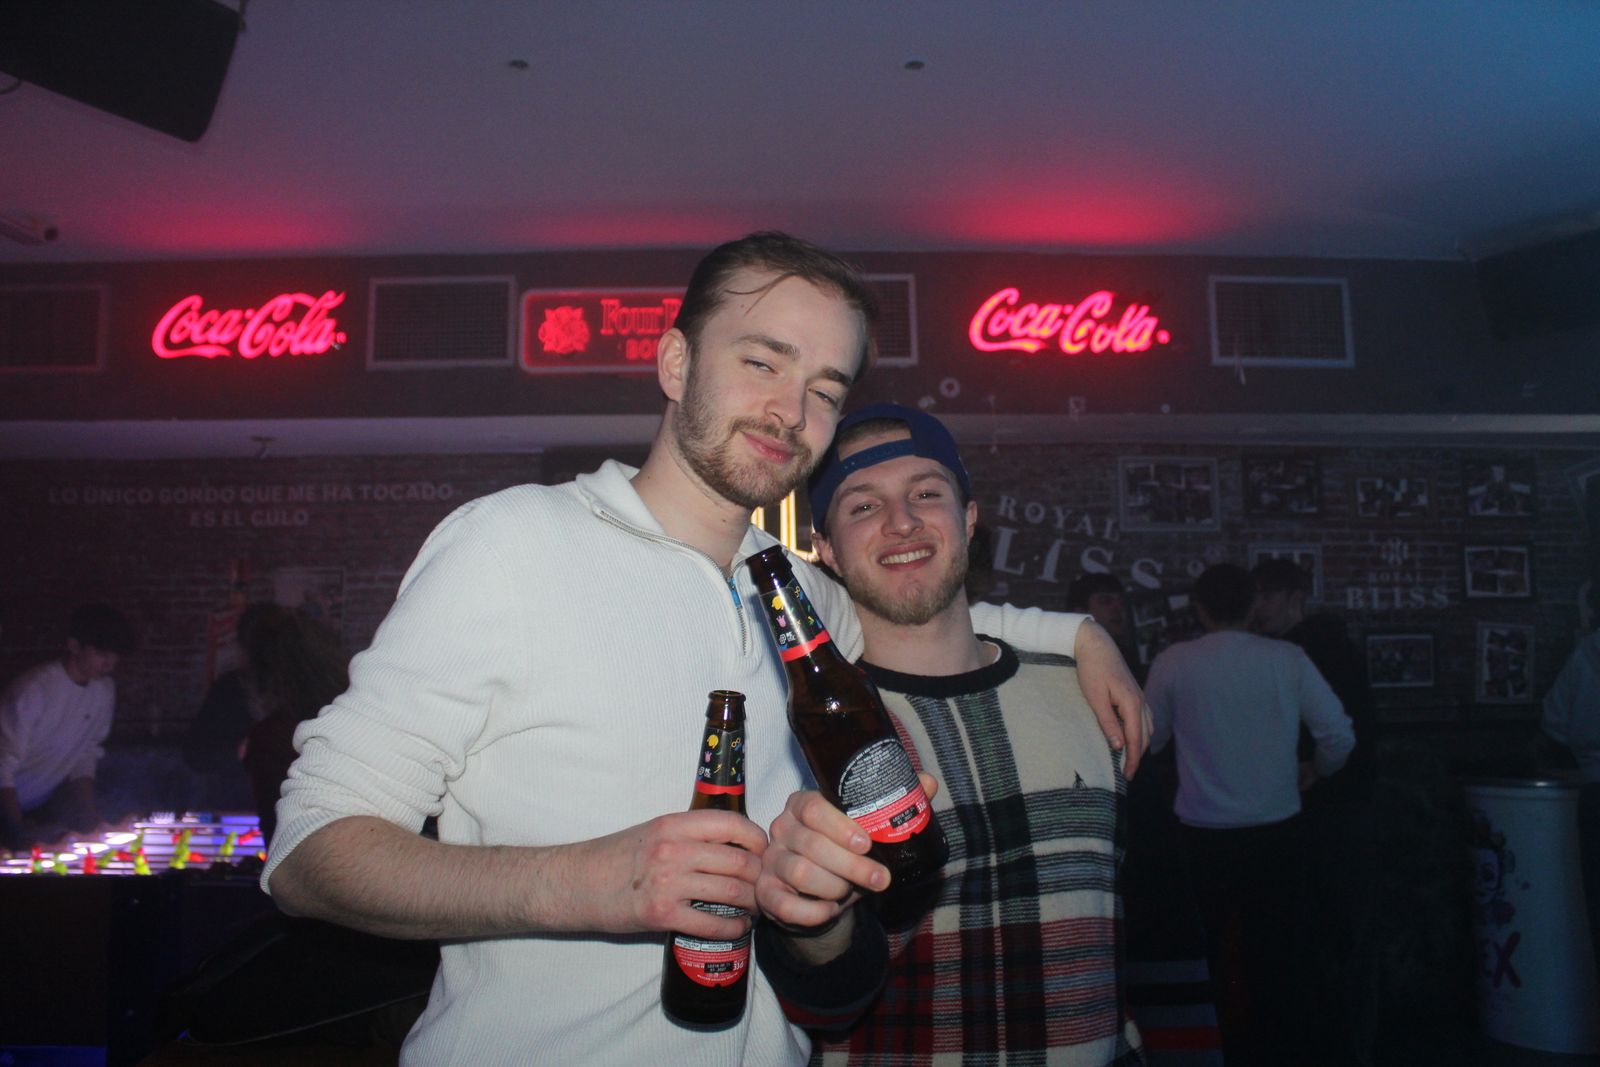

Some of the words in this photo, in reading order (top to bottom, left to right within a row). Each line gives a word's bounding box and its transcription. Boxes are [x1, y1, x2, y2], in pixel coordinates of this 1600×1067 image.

[151, 290, 346, 359] Coca-Cola
[968, 287, 1158, 355] Coca-Cola
[48, 488, 78, 505] LO
[158, 486, 235, 504] GORDO
[240, 486, 283, 504] QUE
[287, 485, 316, 502] ME
[322, 484, 353, 502] HA
[356, 482, 453, 502] TOCADO
[189, 510, 216, 527] ES
[222, 510, 245, 527] EL
[250, 509, 310, 527] CULO
[996, 495, 1120, 543] ROYAL
[991, 525, 1164, 591] LISS
[1345, 585, 1449, 609] BLISS
